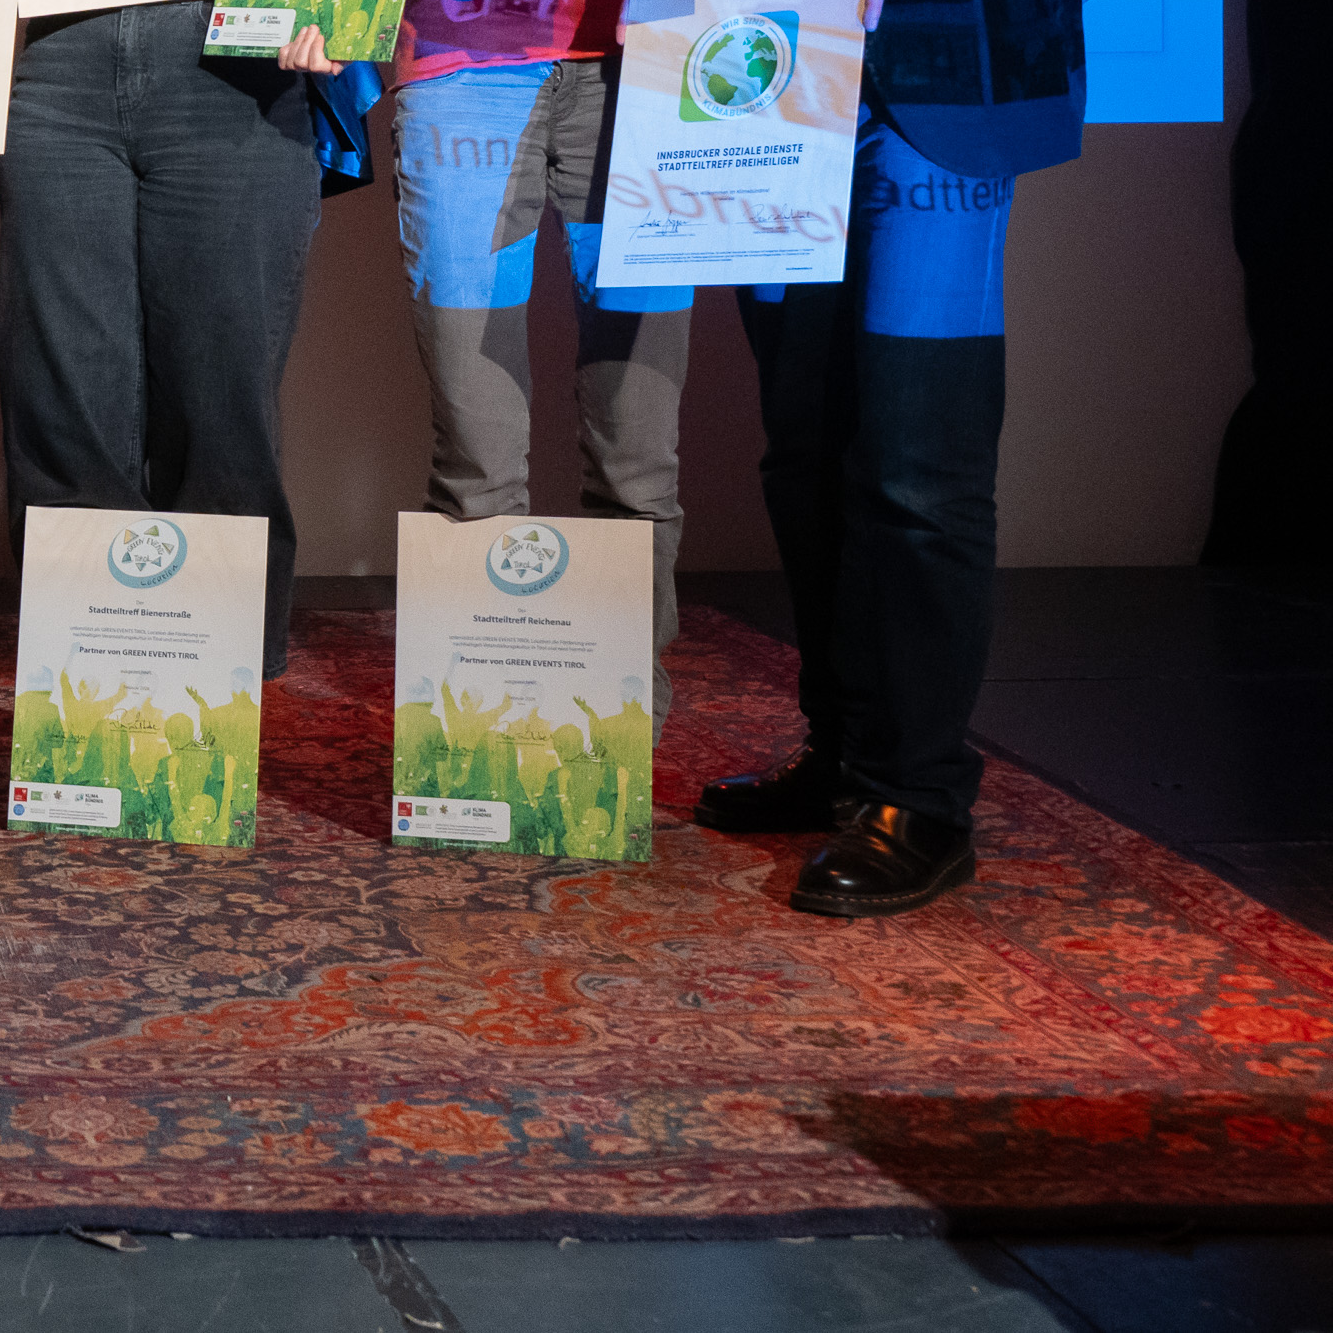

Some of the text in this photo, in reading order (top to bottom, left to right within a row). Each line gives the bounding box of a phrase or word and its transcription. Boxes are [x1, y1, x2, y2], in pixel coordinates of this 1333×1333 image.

[721, 17, 766, 30] WIR SIND
[701, 93, 772, 116] KLIMABÜNDNIS
[657, 144, 803, 159] INNSBRUCKER SOZIALE DIENSTE
[658, 156, 799, 171] STADTTEILTREFF DREIHEILIGEN
[89, 606, 191, 618] Stadtteiltreff Bienerstraße
[473, 615, 571, 626] Stadtteiltreff Reichenau
[108, 648, 120, 656] von
[178, 652, 199, 660] TIROL
[460, 657, 487, 666] Partner
[490, 658, 503, 666] von
[533, 660, 562, 668] EVENTS
[564, 661, 586, 669] TIROL
